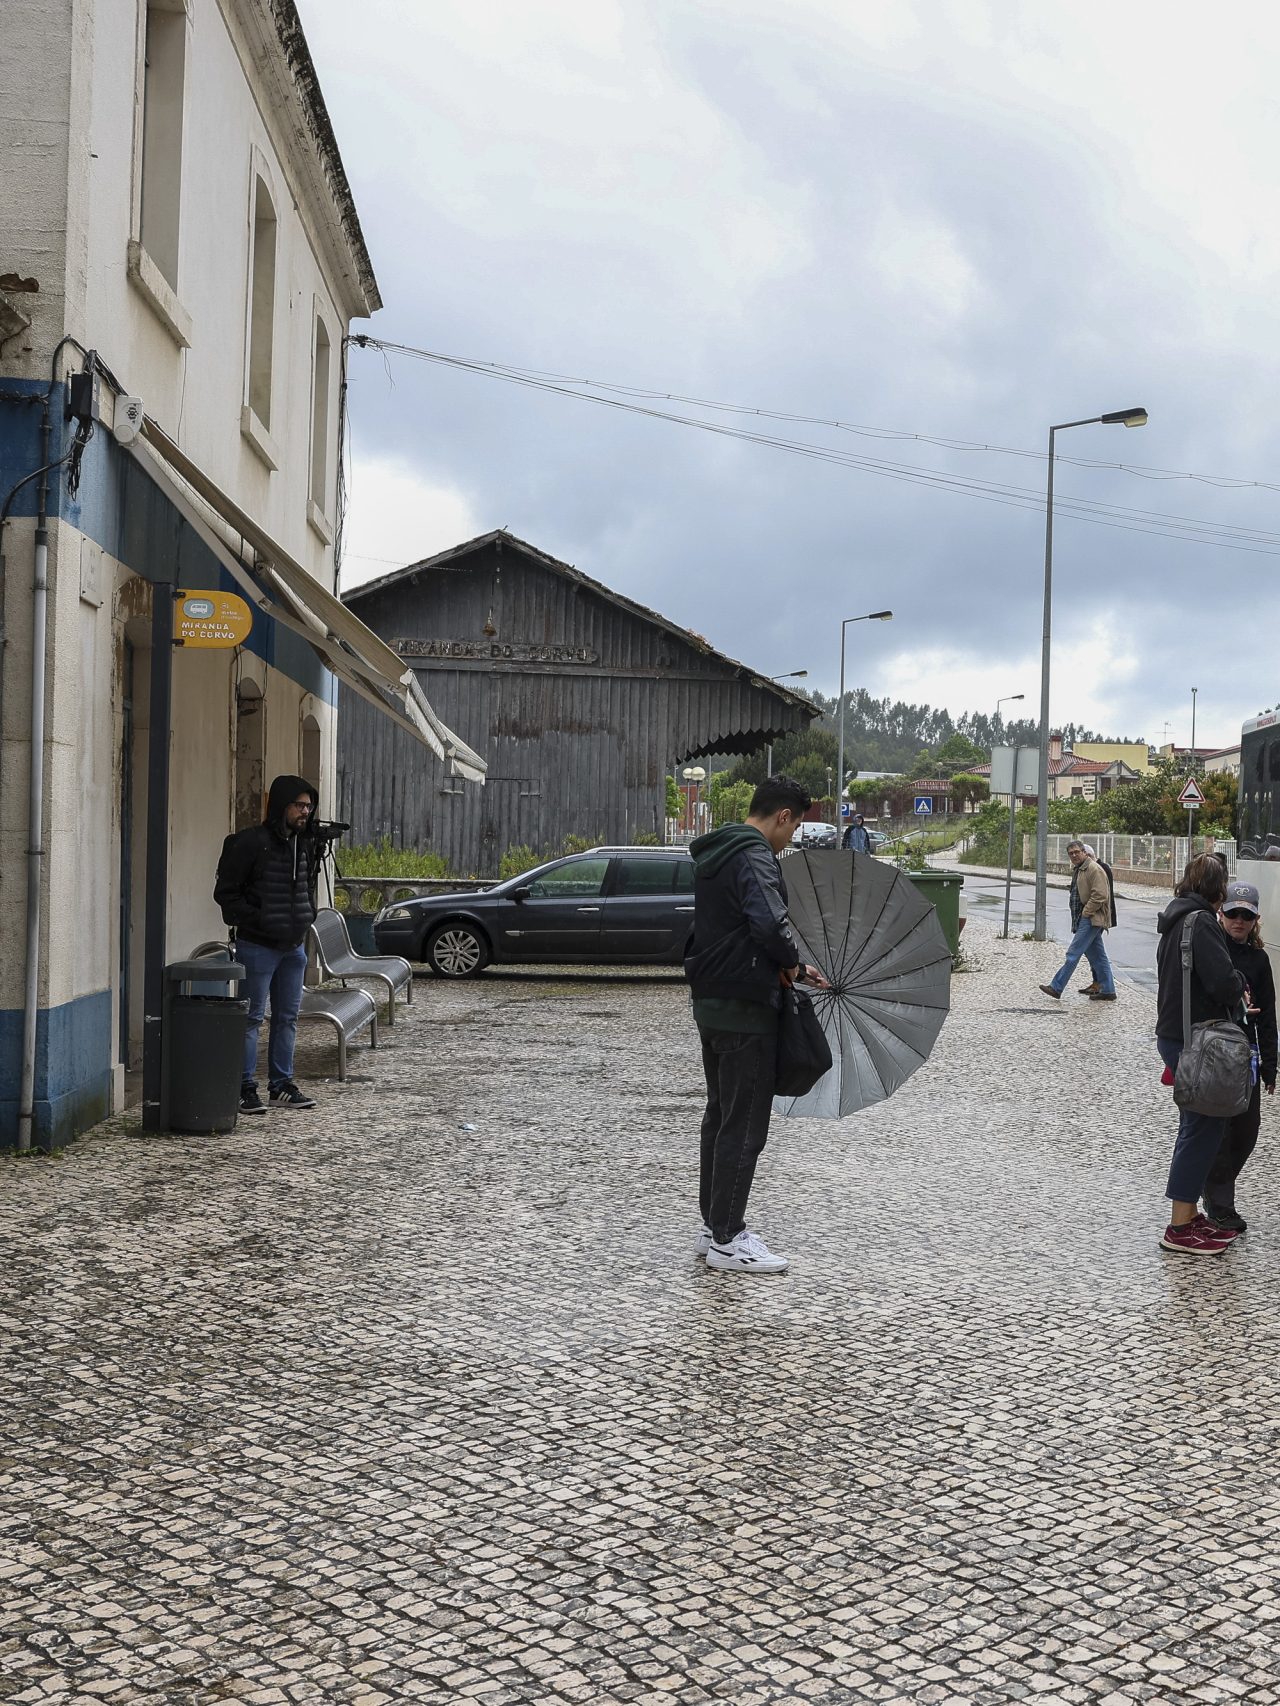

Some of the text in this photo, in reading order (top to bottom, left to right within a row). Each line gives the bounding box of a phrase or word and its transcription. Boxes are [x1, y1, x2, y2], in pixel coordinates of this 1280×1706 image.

[181, 622, 229, 630] MIRANDA
[181, 630, 235, 639] DO CORVO
